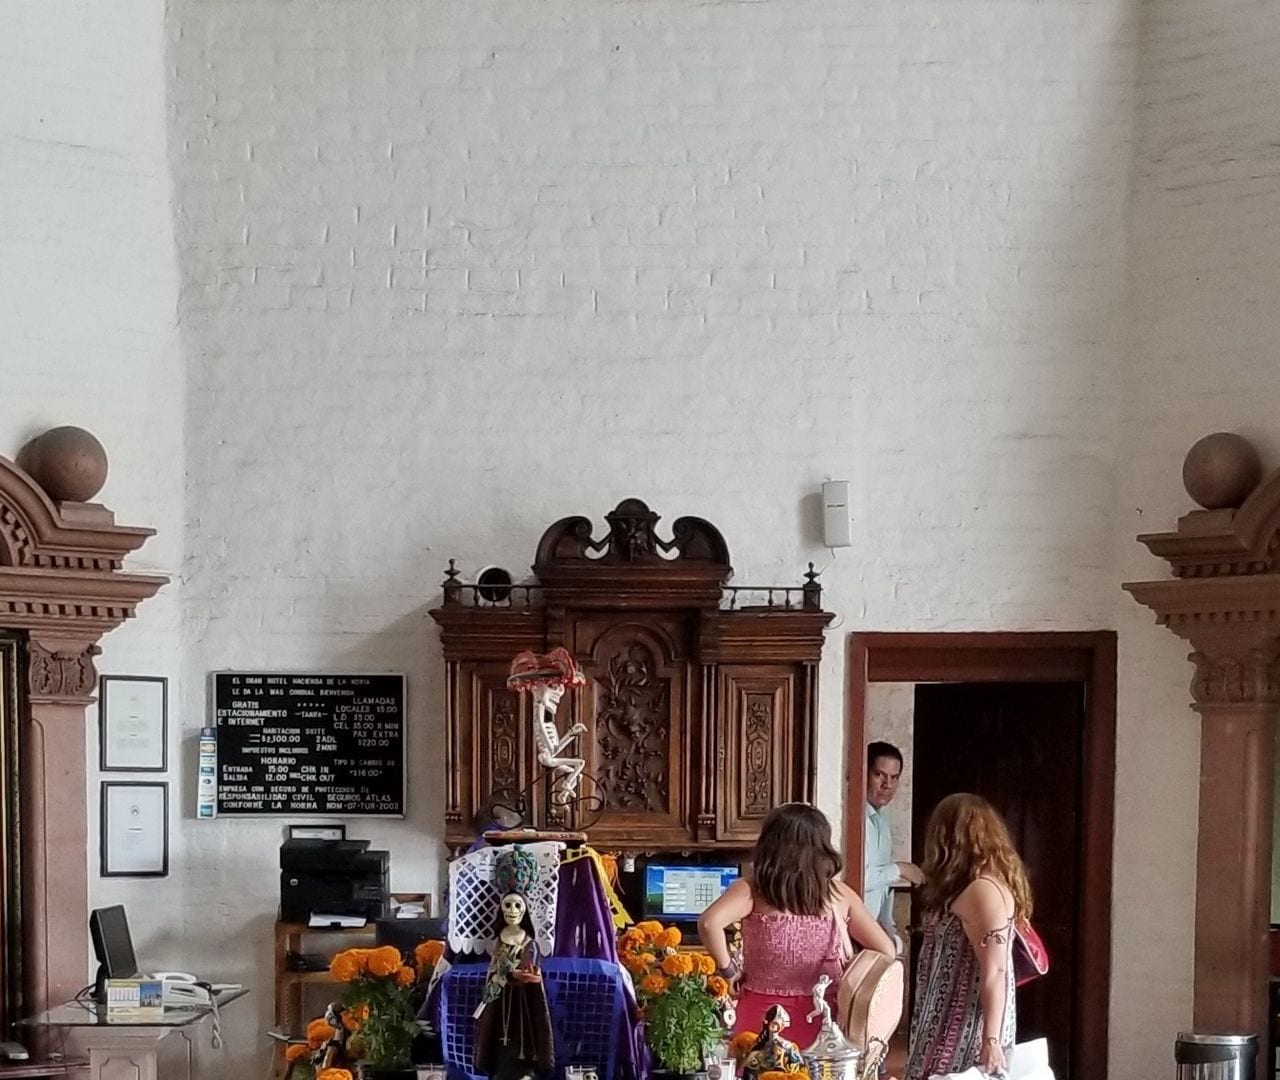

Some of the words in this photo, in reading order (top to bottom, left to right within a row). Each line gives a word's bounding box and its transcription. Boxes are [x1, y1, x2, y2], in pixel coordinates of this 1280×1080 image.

[232, 701, 260, 709] GRATIS
[353, 697, 396, 705] LLAMADAS
[261, 757, 296, 765] HORARIO
